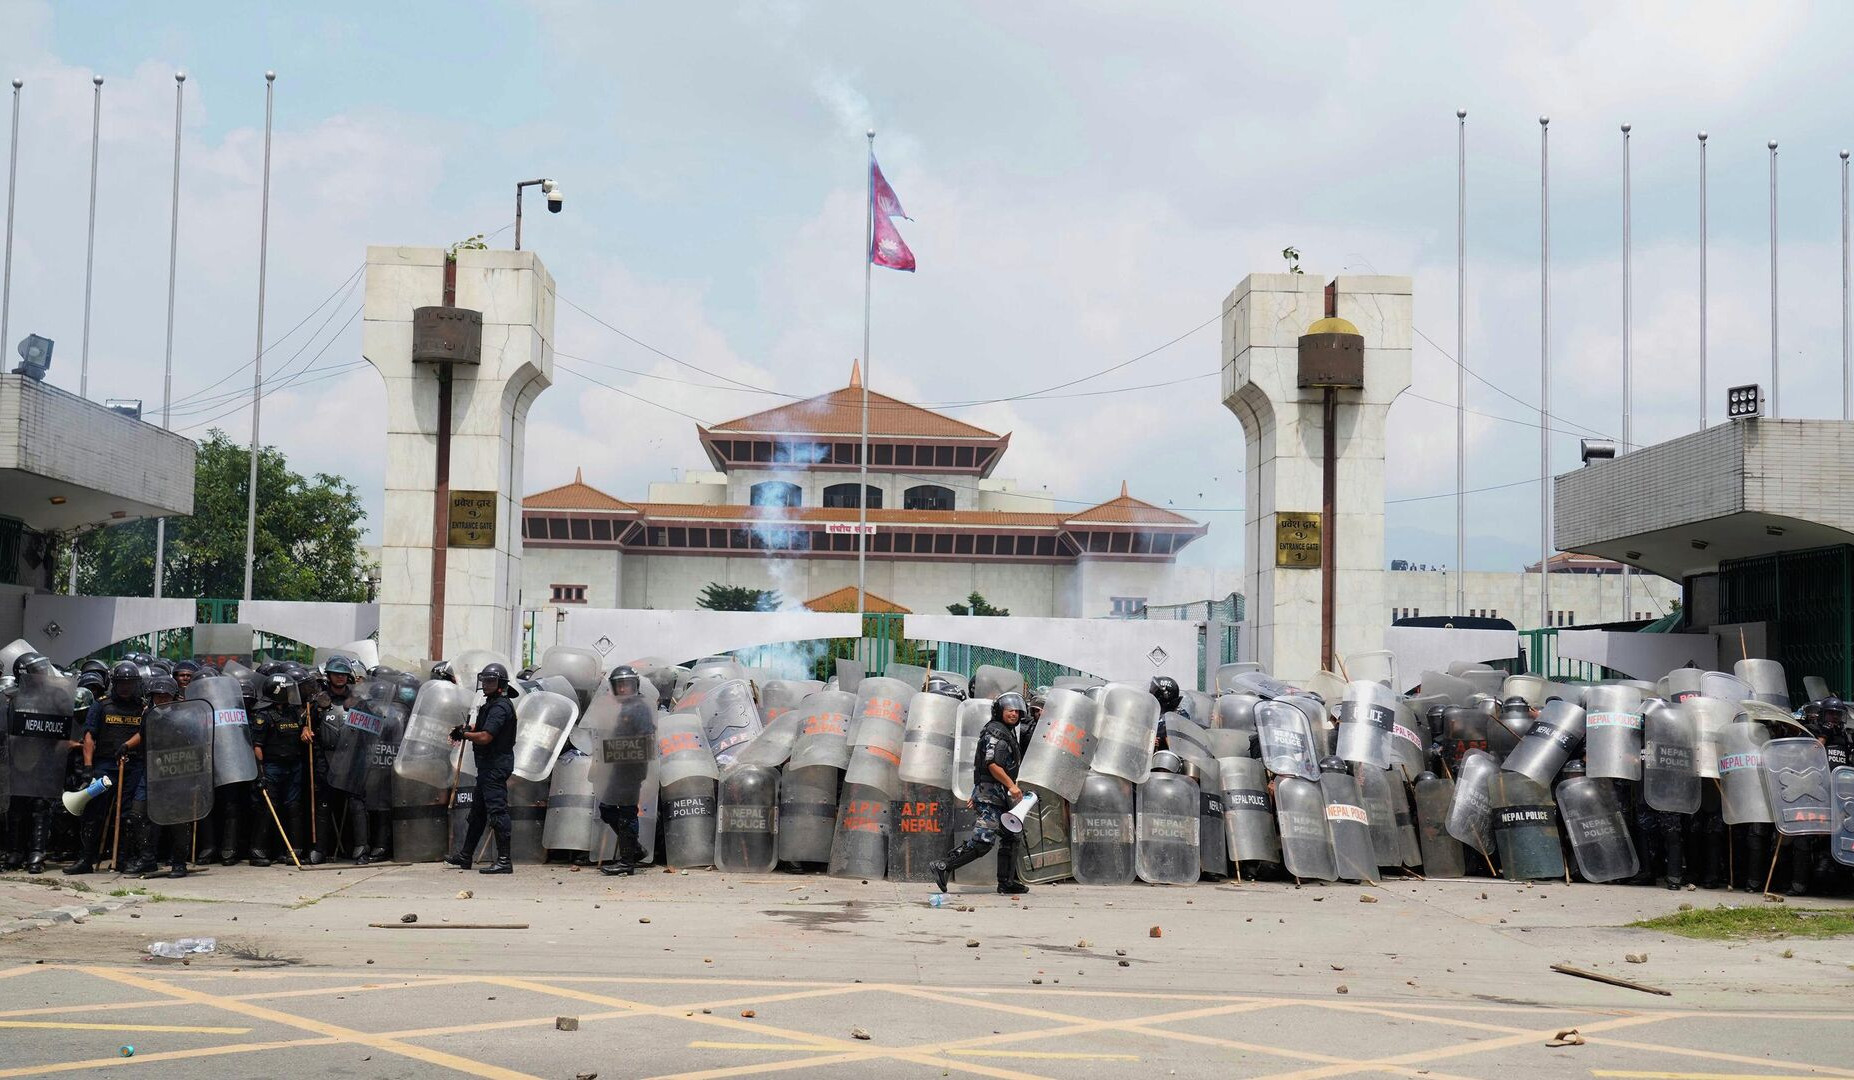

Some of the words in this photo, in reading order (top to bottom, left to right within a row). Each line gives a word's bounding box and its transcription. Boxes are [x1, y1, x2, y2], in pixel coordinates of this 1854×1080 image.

[452, 521, 478, 529] ENTRANCE
[106, 715, 124, 724] NEPAL
[218, 711, 246, 723] POLICE
[350, 712, 371, 727] NEPAL
[1588, 714, 1611, 724] NEPAL
[25, 719, 44, 732] NEPAL
[45, 721, 64, 733] POLICE
[1537, 726, 1551, 736] NEPAL
[608, 739, 642, 750] NEPAL
[1275, 736, 1301, 747] POLICE
[163, 752, 197, 763] NEPAL
[606, 750, 645, 760] POLICE
[1660, 748, 1690, 758] NEPAL
[1828, 749, 1847, 757] NEPAL
[1660, 757, 1690, 767] POLICE
[1721, 757, 1743, 770] NEPAL
[1828, 756, 1847, 764] POLICE
[161, 762, 200, 775] POLICE
[458, 793, 473, 802] NEPAL
[1232, 796, 1248, 804] NEPAL
[1248, 796, 1264, 806] POLICE
[674, 798, 705, 808] NEPAL
[673, 807, 706, 817] POLICE
[733, 808, 764, 818] NEPAL
[1327, 806, 1350, 817] NEPAL
[1351, 808, 1367, 821] POLICE
[1502, 812, 1525, 822] NEPAL
[1525, 811, 1548, 820] POLICE
[731, 819, 766, 829] POLICE
[901, 818, 941, 832] NEPAL
[1087, 818, 1119, 828] NEPAL
[1152, 818, 1183, 828] NEPAL
[1581, 818, 1612, 830] NEPAL
[1087, 828, 1120, 837] POLICE
[1151, 828, 1184, 838] POLICE
[1583, 826, 1616, 838] POLICE
